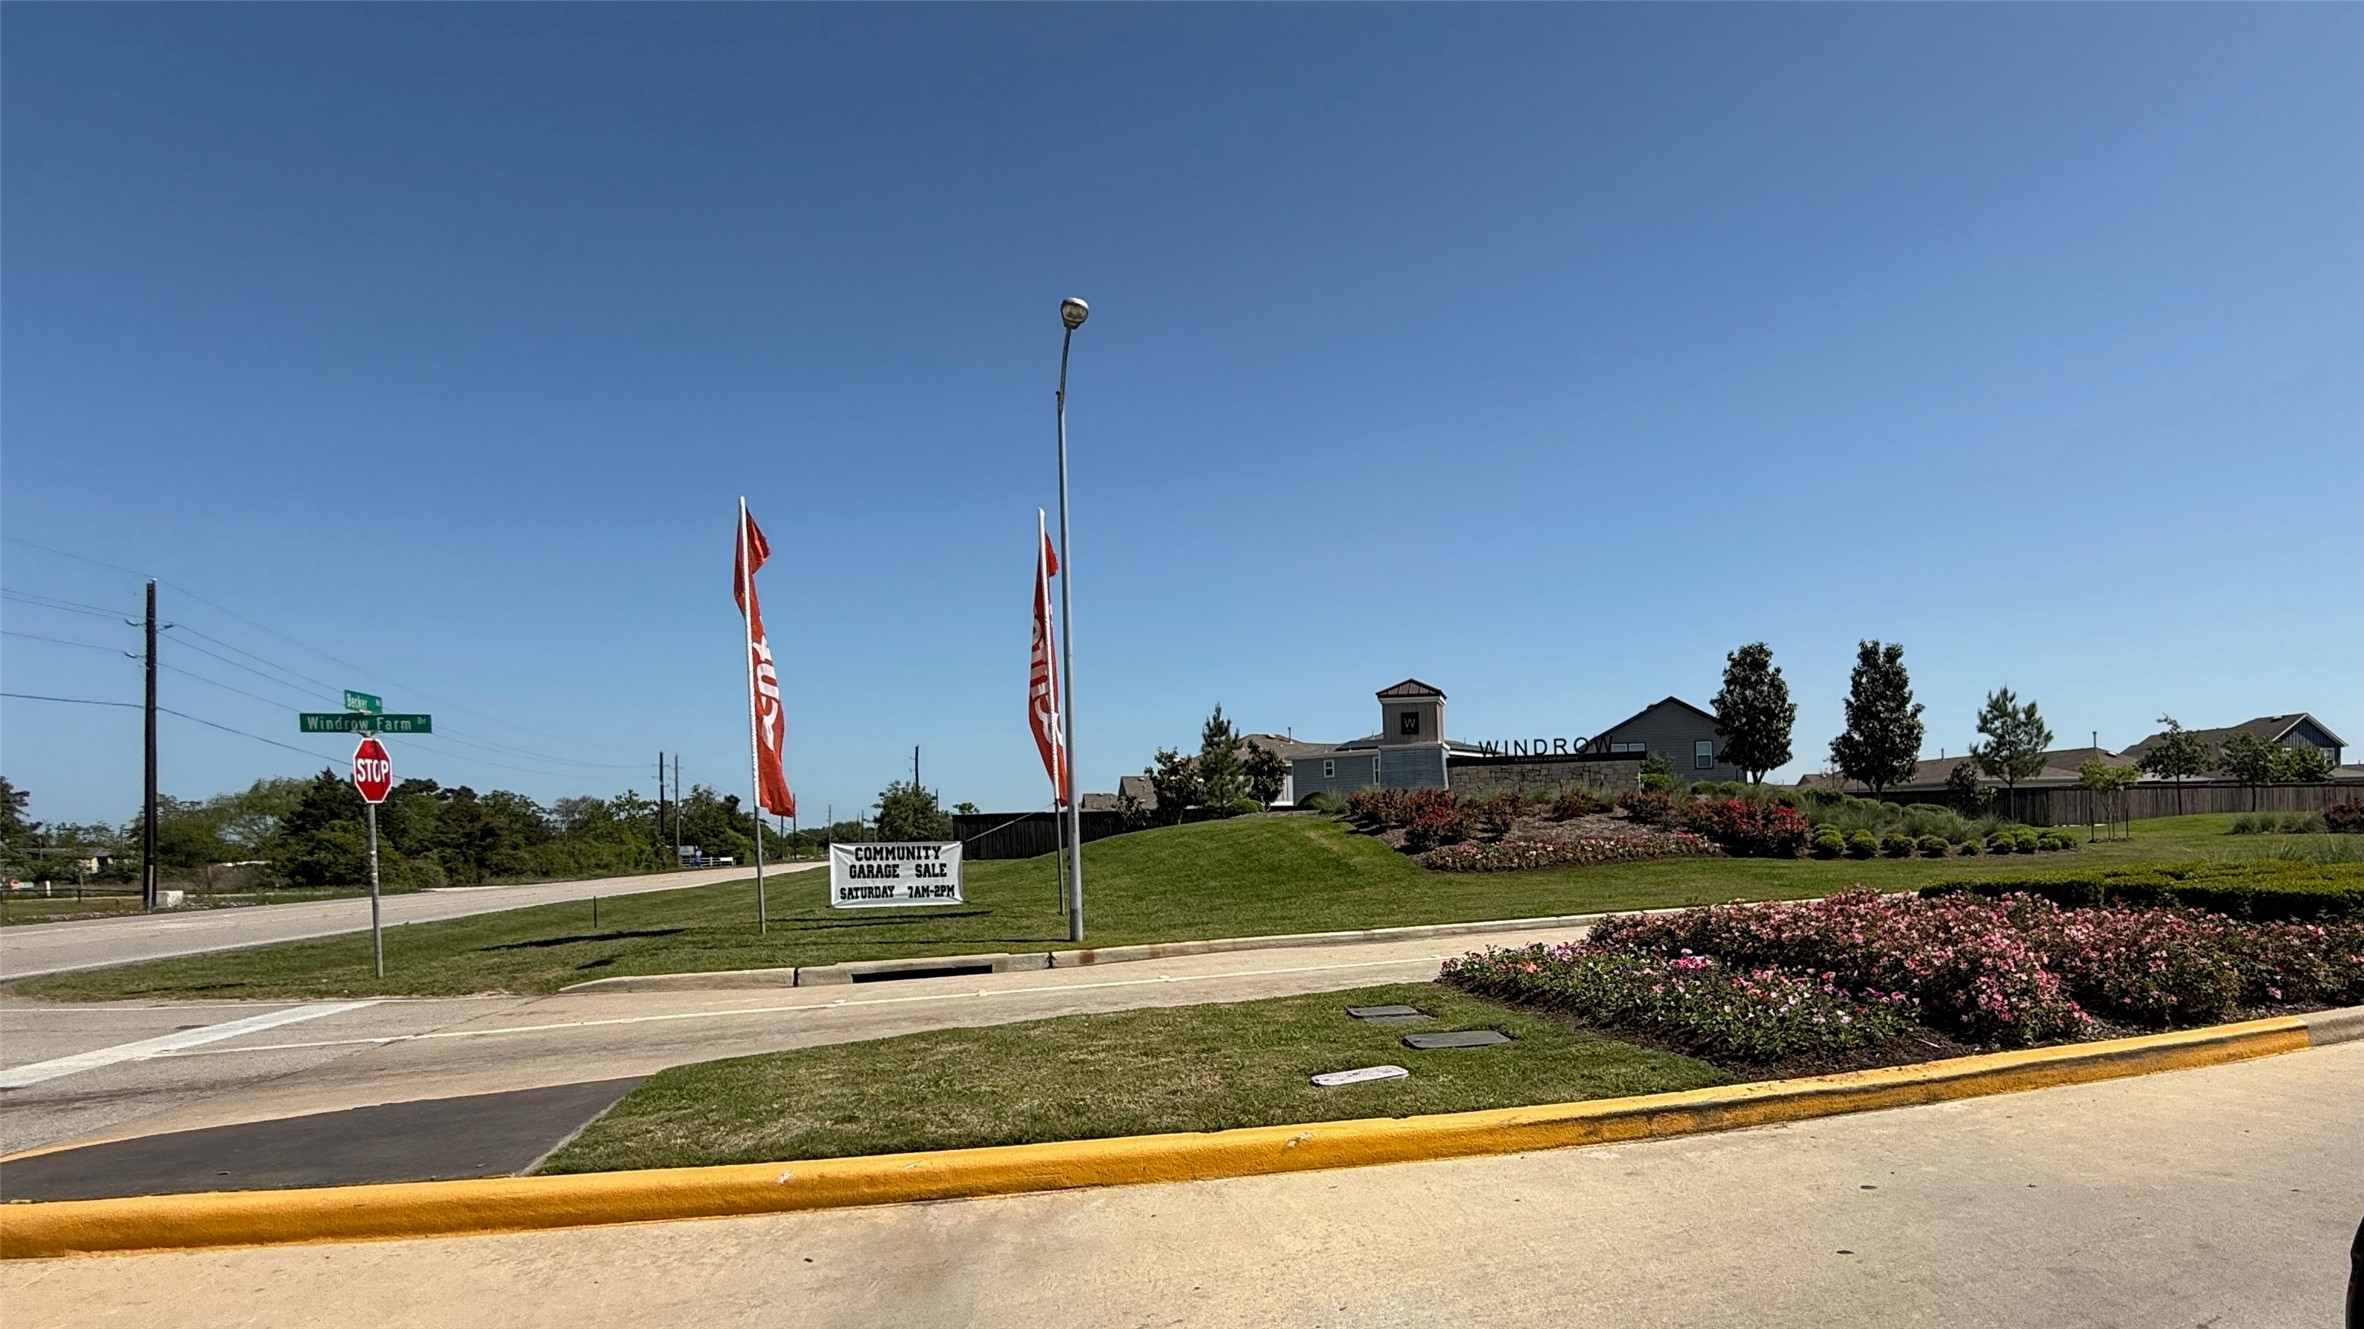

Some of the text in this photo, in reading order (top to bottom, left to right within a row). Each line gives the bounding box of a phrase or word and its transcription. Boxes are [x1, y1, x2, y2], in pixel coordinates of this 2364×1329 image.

[307, 716, 426, 731] Windrow Farm Dr
[1403, 717, 1416, 729] W
[1478, 736, 1613, 757] WINDROW
[357, 758, 388, 783] STOP
[854, 845, 941, 862] COMMUNITY
[849, 863, 947, 879] GARAGE SALE
[840, 884, 955, 900] SATURDAY 7AM-2PM
